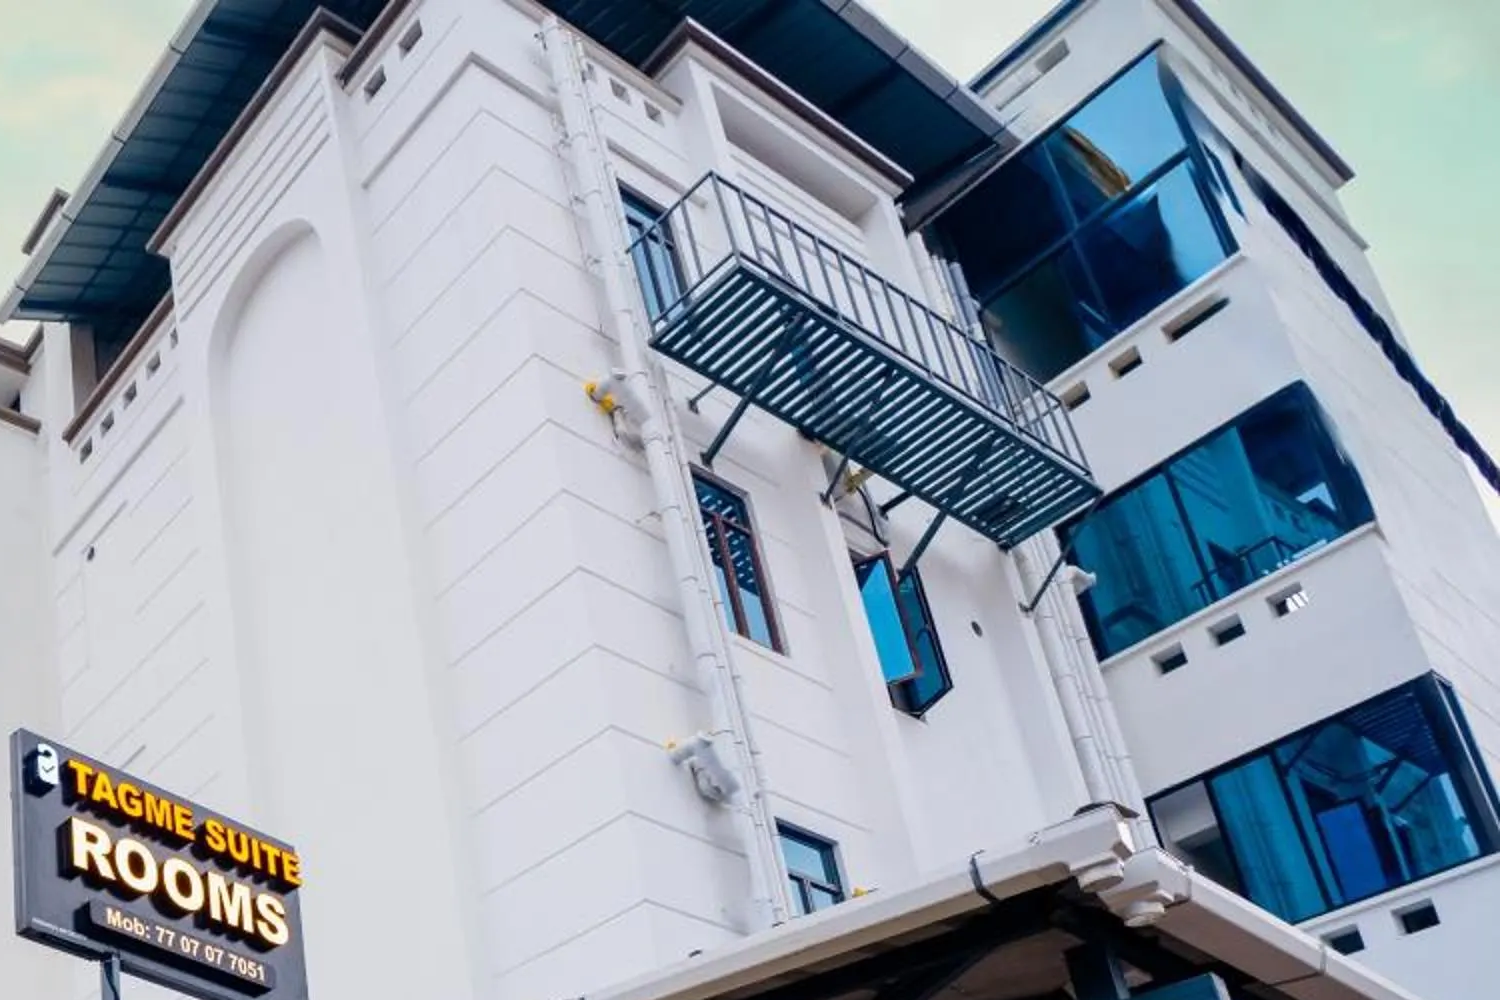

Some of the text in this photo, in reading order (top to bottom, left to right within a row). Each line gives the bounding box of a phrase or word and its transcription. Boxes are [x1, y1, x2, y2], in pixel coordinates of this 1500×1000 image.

[67, 758, 303, 886] TAGME SUITE
[70, 815, 290, 946] ROOMS
[106, 907, 151, 938] Mob:
[155, 924, 175, 947] 77
[180, 935, 200, 956] 07
[205, 944, 225, 965] 07
[228, 953, 265, 982] 7051
